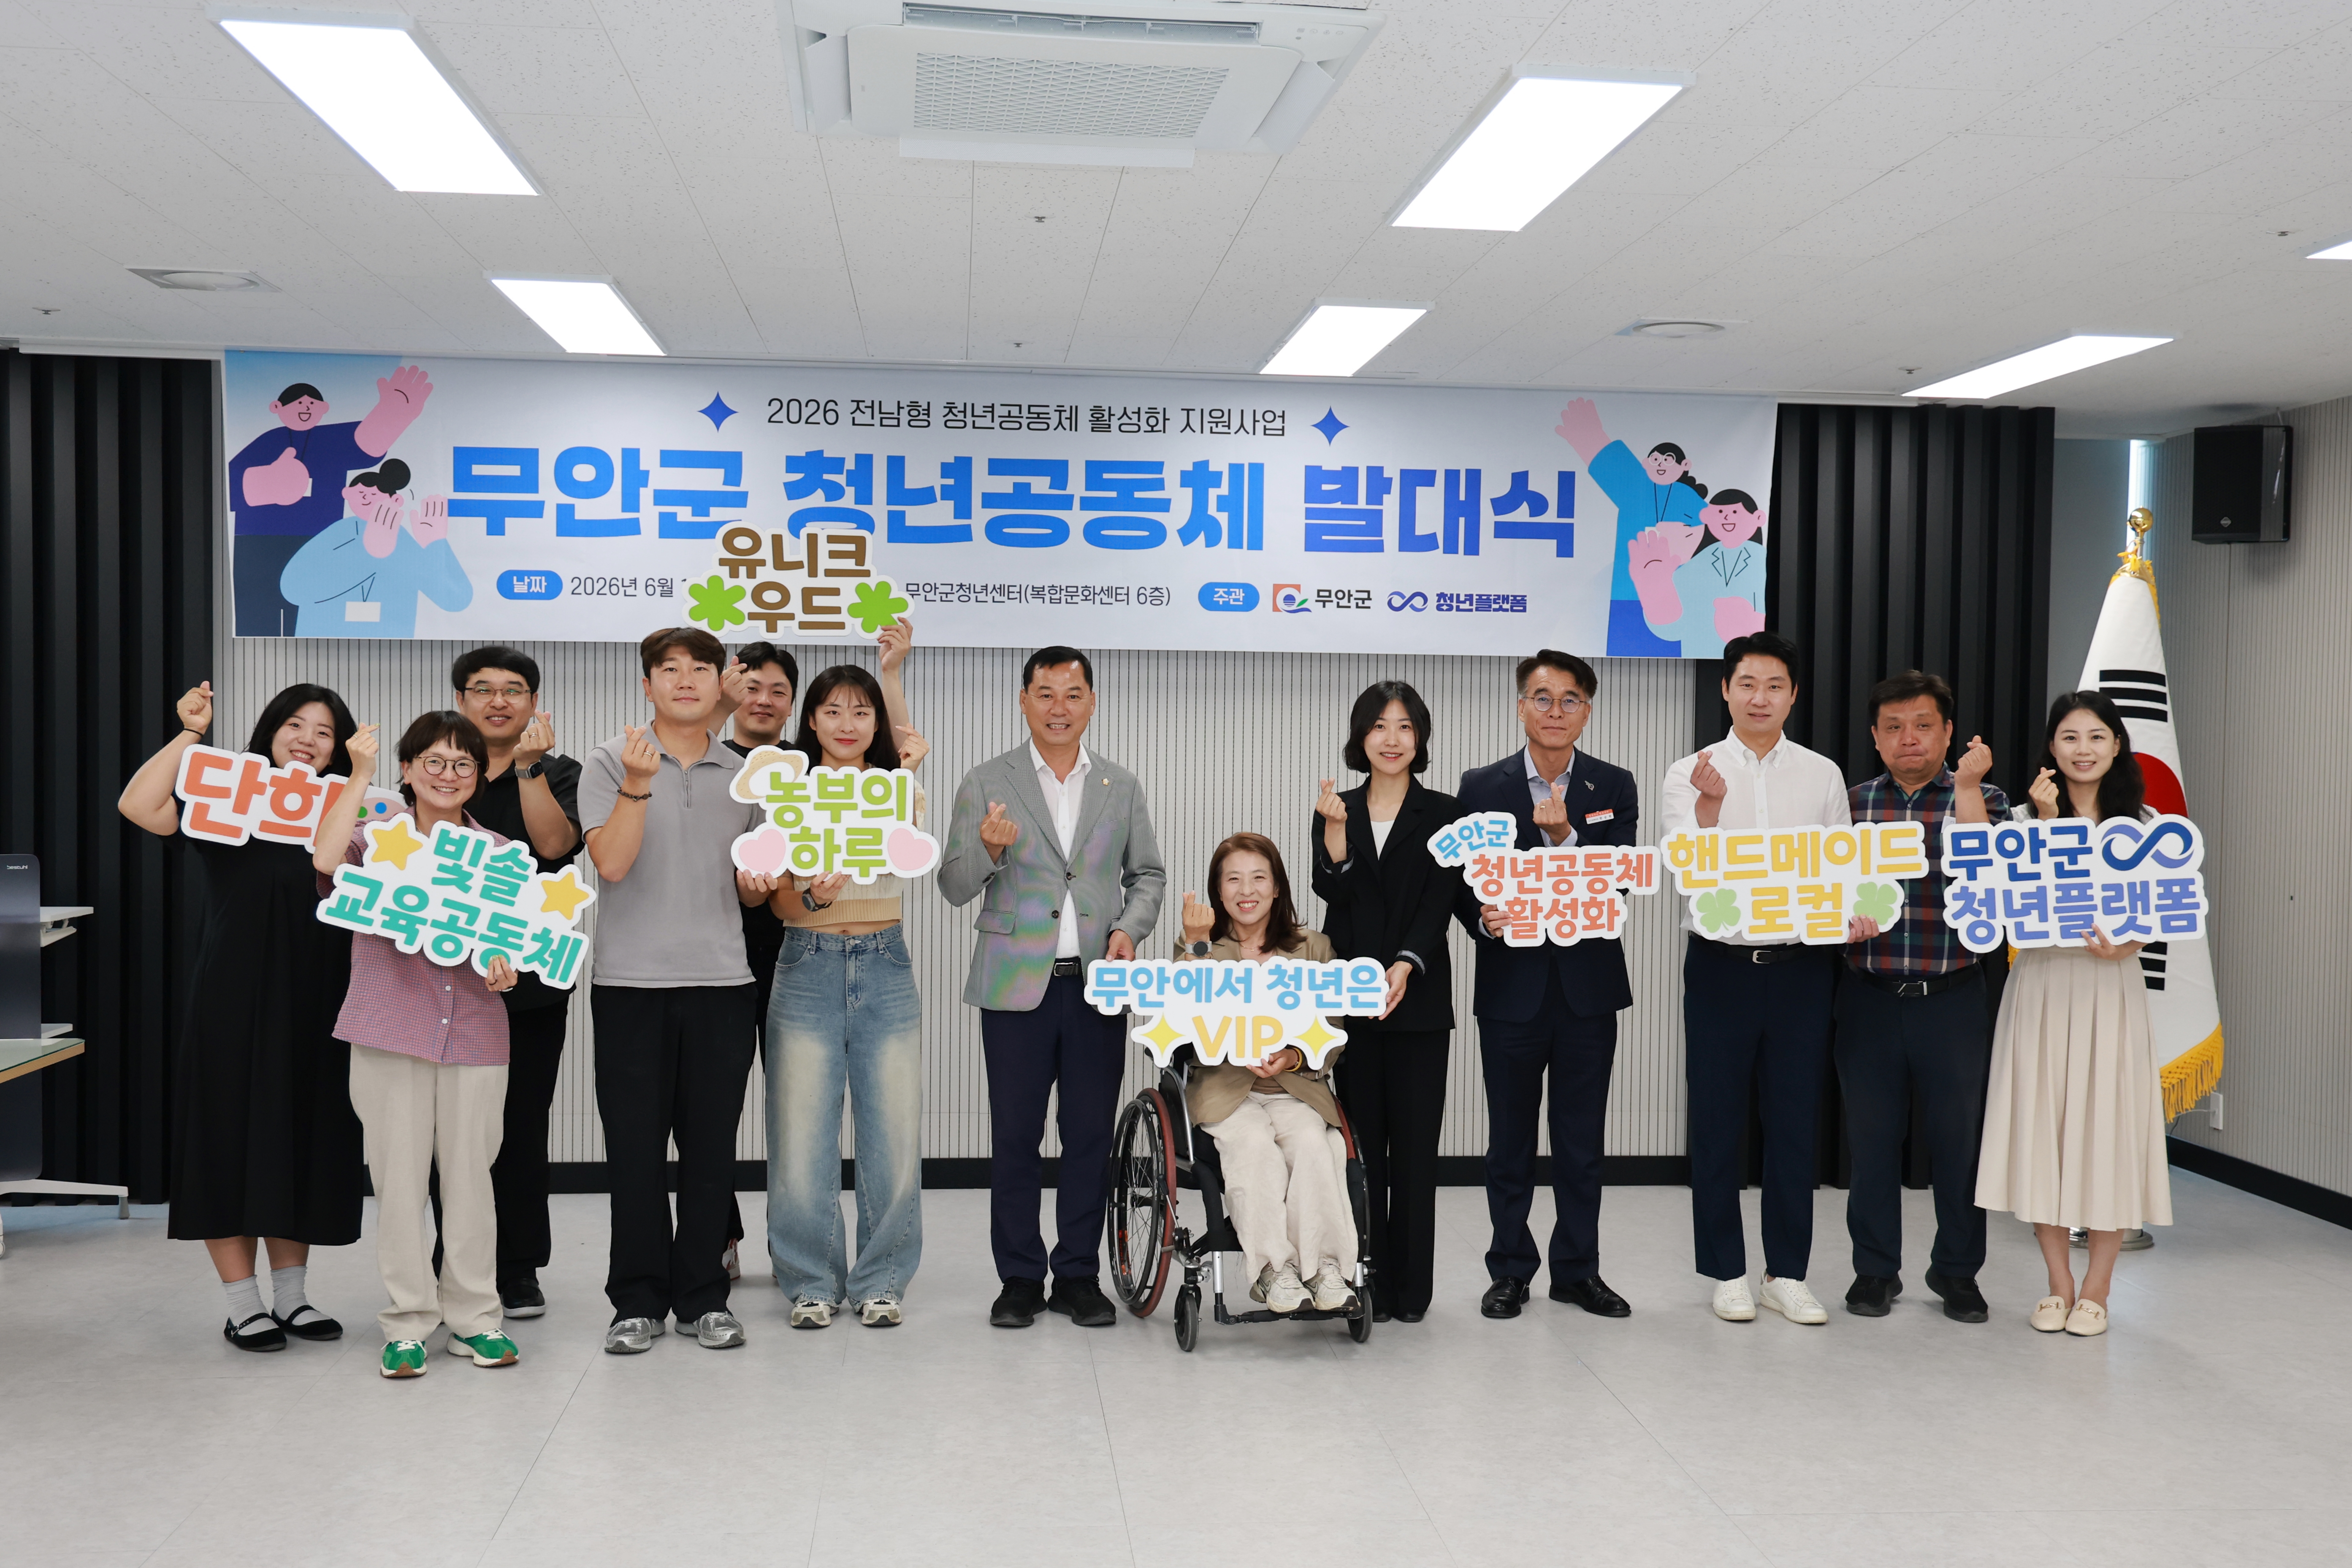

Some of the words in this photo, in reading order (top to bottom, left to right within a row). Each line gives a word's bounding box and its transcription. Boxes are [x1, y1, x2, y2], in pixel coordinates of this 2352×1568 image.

[768, 398, 839, 425] 2026
[850, 400, 930, 428] 전남형
[943, 402, 1078, 432] 청년공동체
[1089, 406, 1170, 434] 활성화
[1180, 409, 1286, 436] 지원사업
[448, 446, 748, 539] 무안군
[783, 450, 1264, 550] 청년공동체
[1305, 465, 1575, 558] 발대식
[719, 527, 870, 579] 유니크
[513, 576, 547, 593] 날짜
[571, 577, 637, 596] 2026년
[645, 578, 673, 597] 6월
[748, 581, 845, 633] 우드
[906, 582, 1130, 605] 무안군청년센터(복합문화센터
[1137, 586, 1171, 606] 6층)
[1213, 588, 1245, 605] 주관
[1315, 589, 1372, 609] 무안군
[1436, 592, 1527, 613] 청년플랫폼
[766, 772, 907, 828] 농부의
[789, 826, 886, 877] 하루
[1436, 820, 1509, 859] 무안군
[1668, 828, 1922, 888] 핸드메이드
[1949, 826, 2092, 881] 무안군
[431, 829, 530, 907] 빛솔
[1471, 853, 1653, 896] 청년공동체
[325, 871, 583, 983] 교육공동체
[1505, 896, 1620, 939] 활성화
[1749, 883, 1843, 939] 로컬
[1951, 878, 2200, 945] 청년플랫폼
[1092, 967, 1252, 1008] 무안에서
[1267, 964, 1382, 1010] 청년은
[1192, 1016, 1283, 1058] VIP
